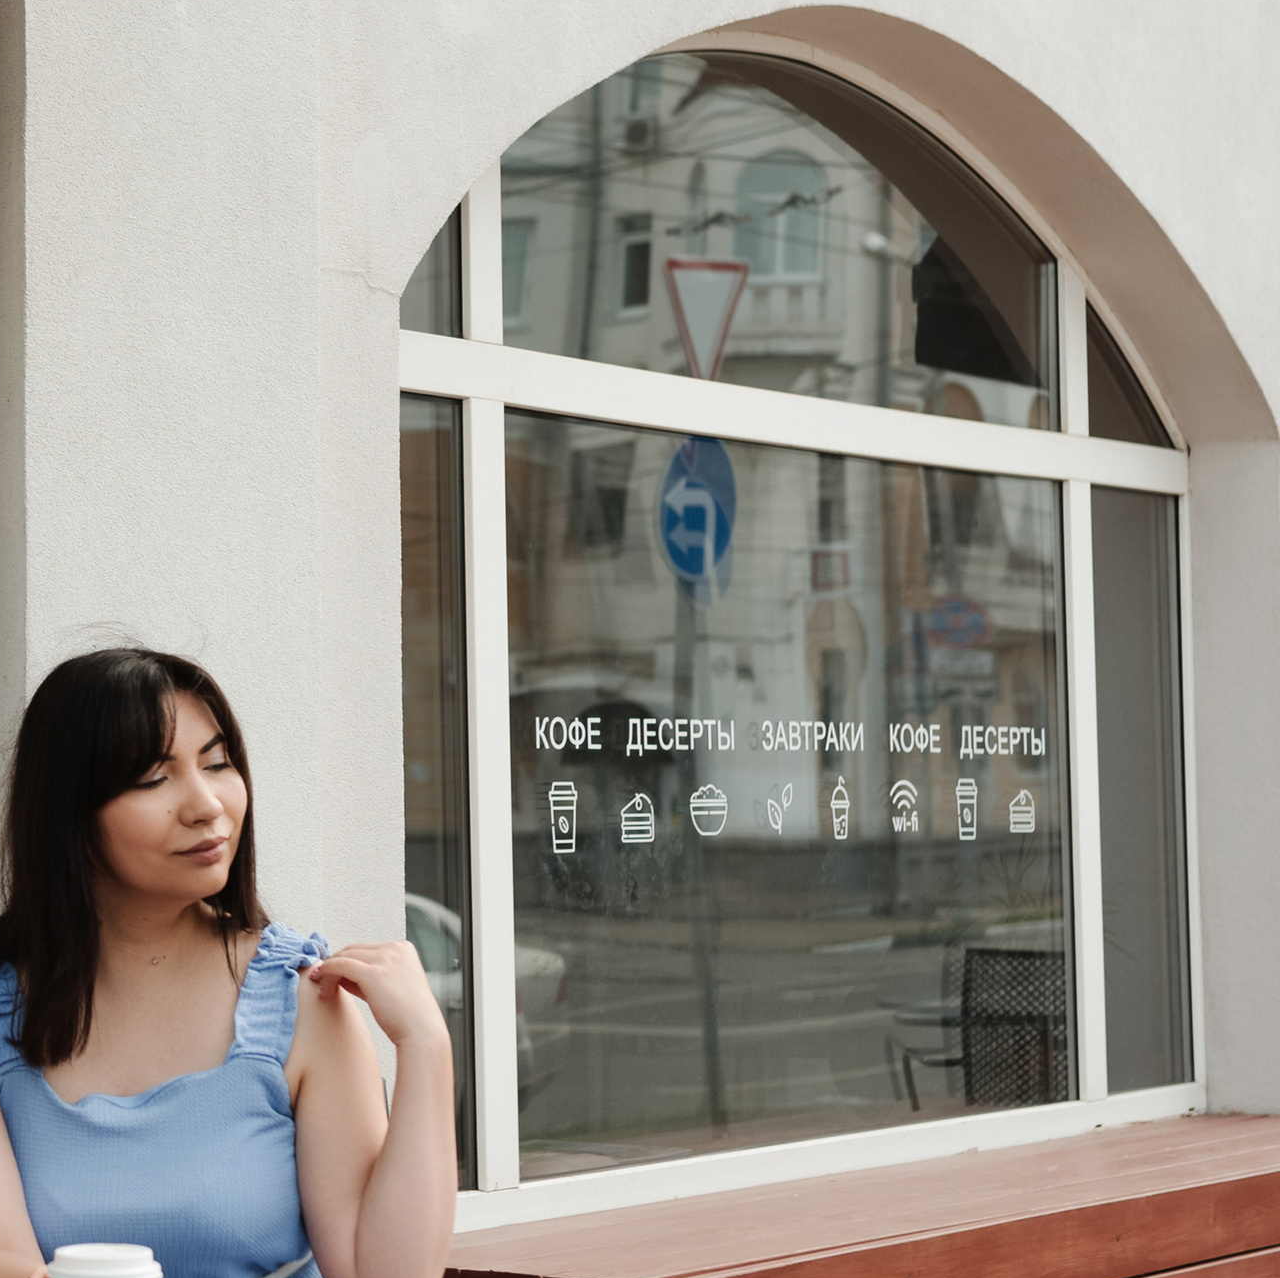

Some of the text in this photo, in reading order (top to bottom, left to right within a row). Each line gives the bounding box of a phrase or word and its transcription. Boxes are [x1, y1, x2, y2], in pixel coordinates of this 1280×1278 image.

[535, 716, 1046, 760] КОФЕ ДЕСЕРТЫ ЗАВТРАКИ КОФЕ ДЕСЕРТЫ
[892, 812, 919, 833] wi-fi
